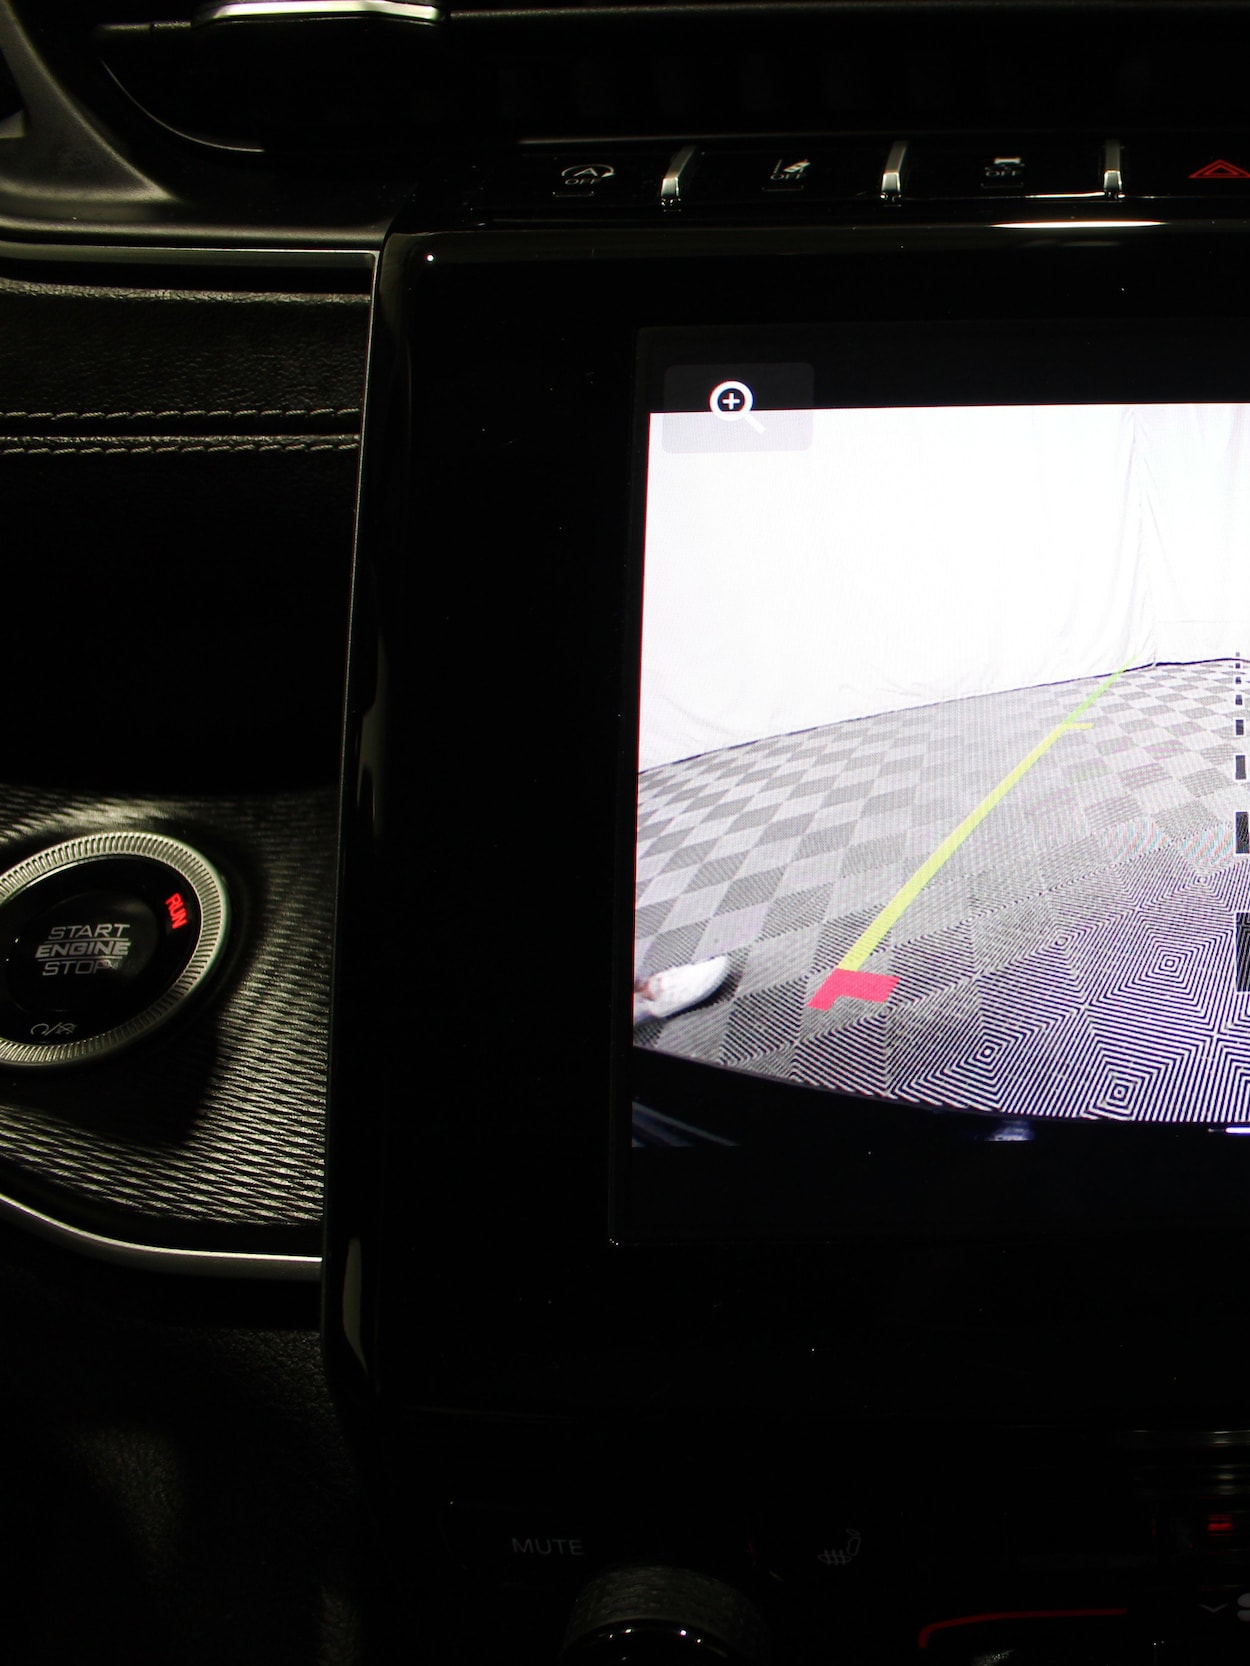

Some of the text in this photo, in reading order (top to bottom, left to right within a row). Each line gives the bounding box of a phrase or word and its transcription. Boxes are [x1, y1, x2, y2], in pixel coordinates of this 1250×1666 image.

[164, 892, 189, 930] RUN
[48, 923, 131, 940] START
[34, 940, 132, 959] ENGINE
[42, 959, 113, 976] STOP
[511, 1537, 585, 1556] MUTE
